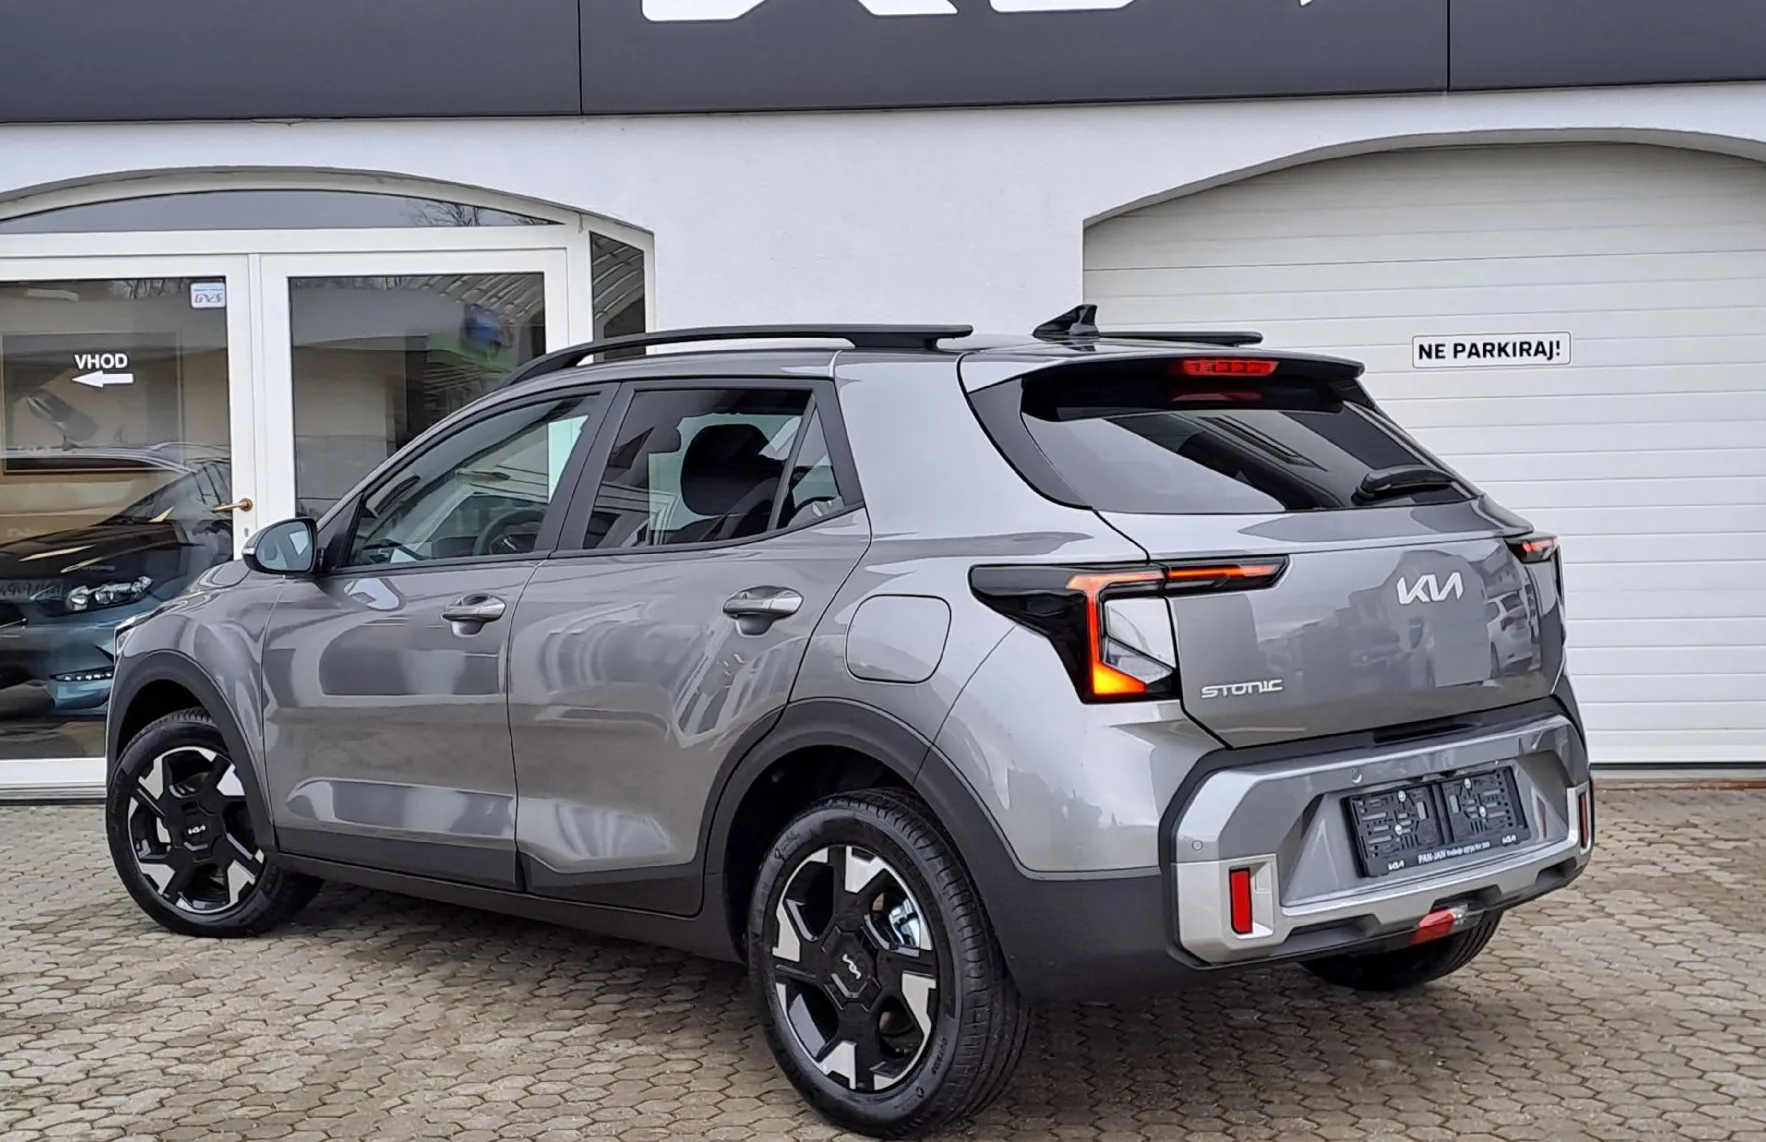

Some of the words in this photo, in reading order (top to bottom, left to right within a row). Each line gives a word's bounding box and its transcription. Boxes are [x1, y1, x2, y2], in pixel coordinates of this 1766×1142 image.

[1418, 343, 1446, 360] NE
[1453, 340, 1561, 361] PARKIRAJ!
[74, 353, 128, 370] VHOD
[1396, 572, 1464, 605] KIA
[1201, 678, 1284, 699] STONIC
